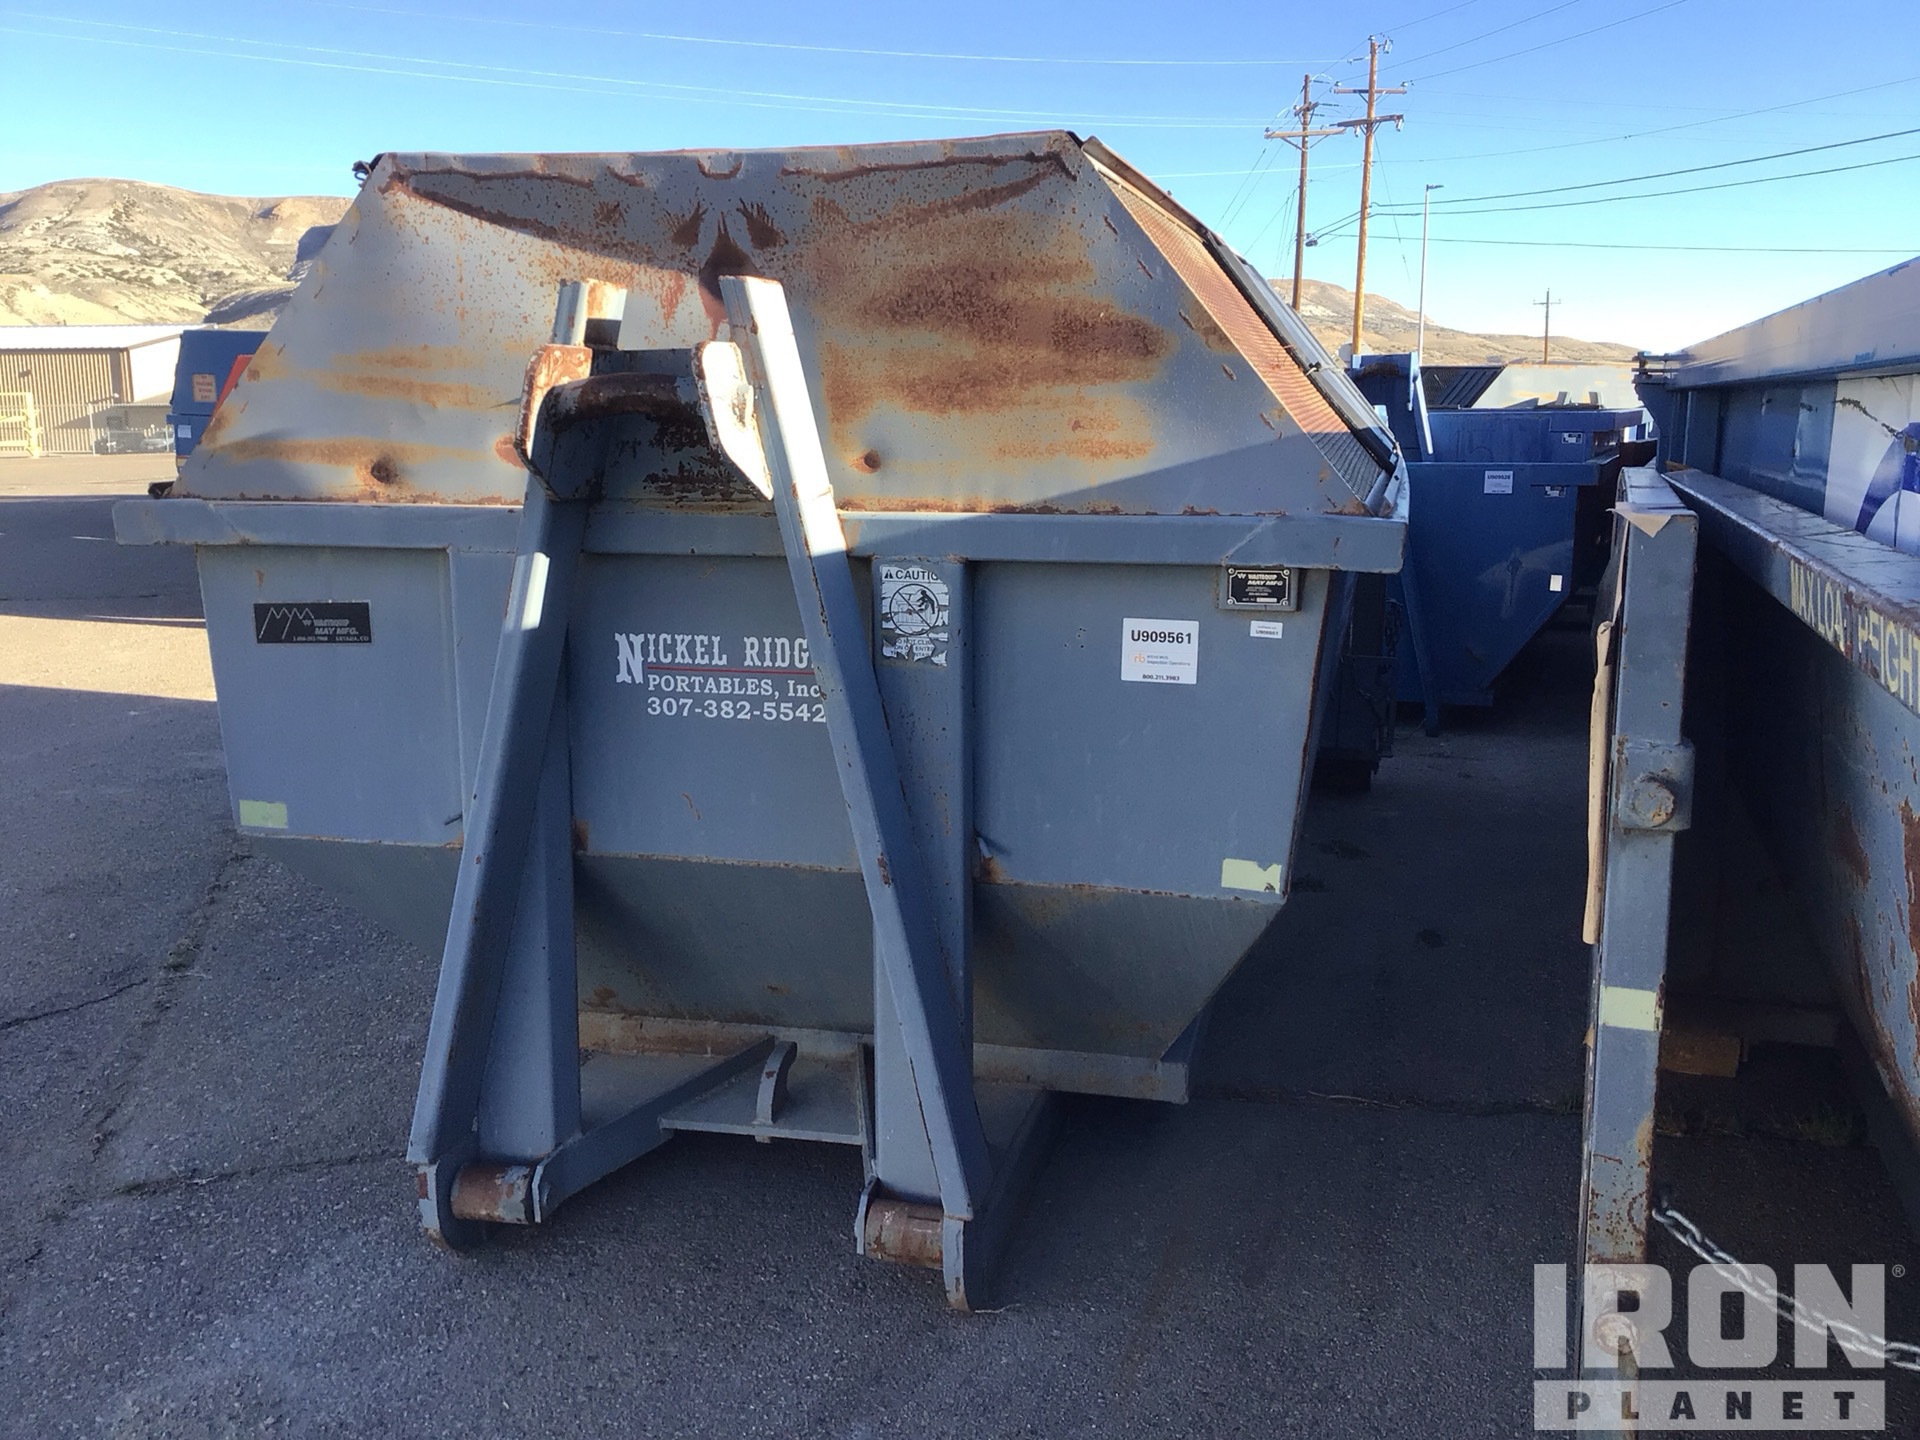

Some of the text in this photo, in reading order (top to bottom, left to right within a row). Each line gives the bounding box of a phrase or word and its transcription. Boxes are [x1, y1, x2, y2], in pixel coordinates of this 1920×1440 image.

[895, 569, 939, 581] CAUTIO
[1790, 558, 1815, 628] MAX
[1817, 577, 1847, 653] LOA
[314, 627, 335, 635] MAY
[1131, 629, 1192, 644] U909561
[614, 632, 815, 685] NICKEL RIDG
[647, 674, 780, 700] PORTABLES,
[647, 697, 827, 723] 307-382-5542
